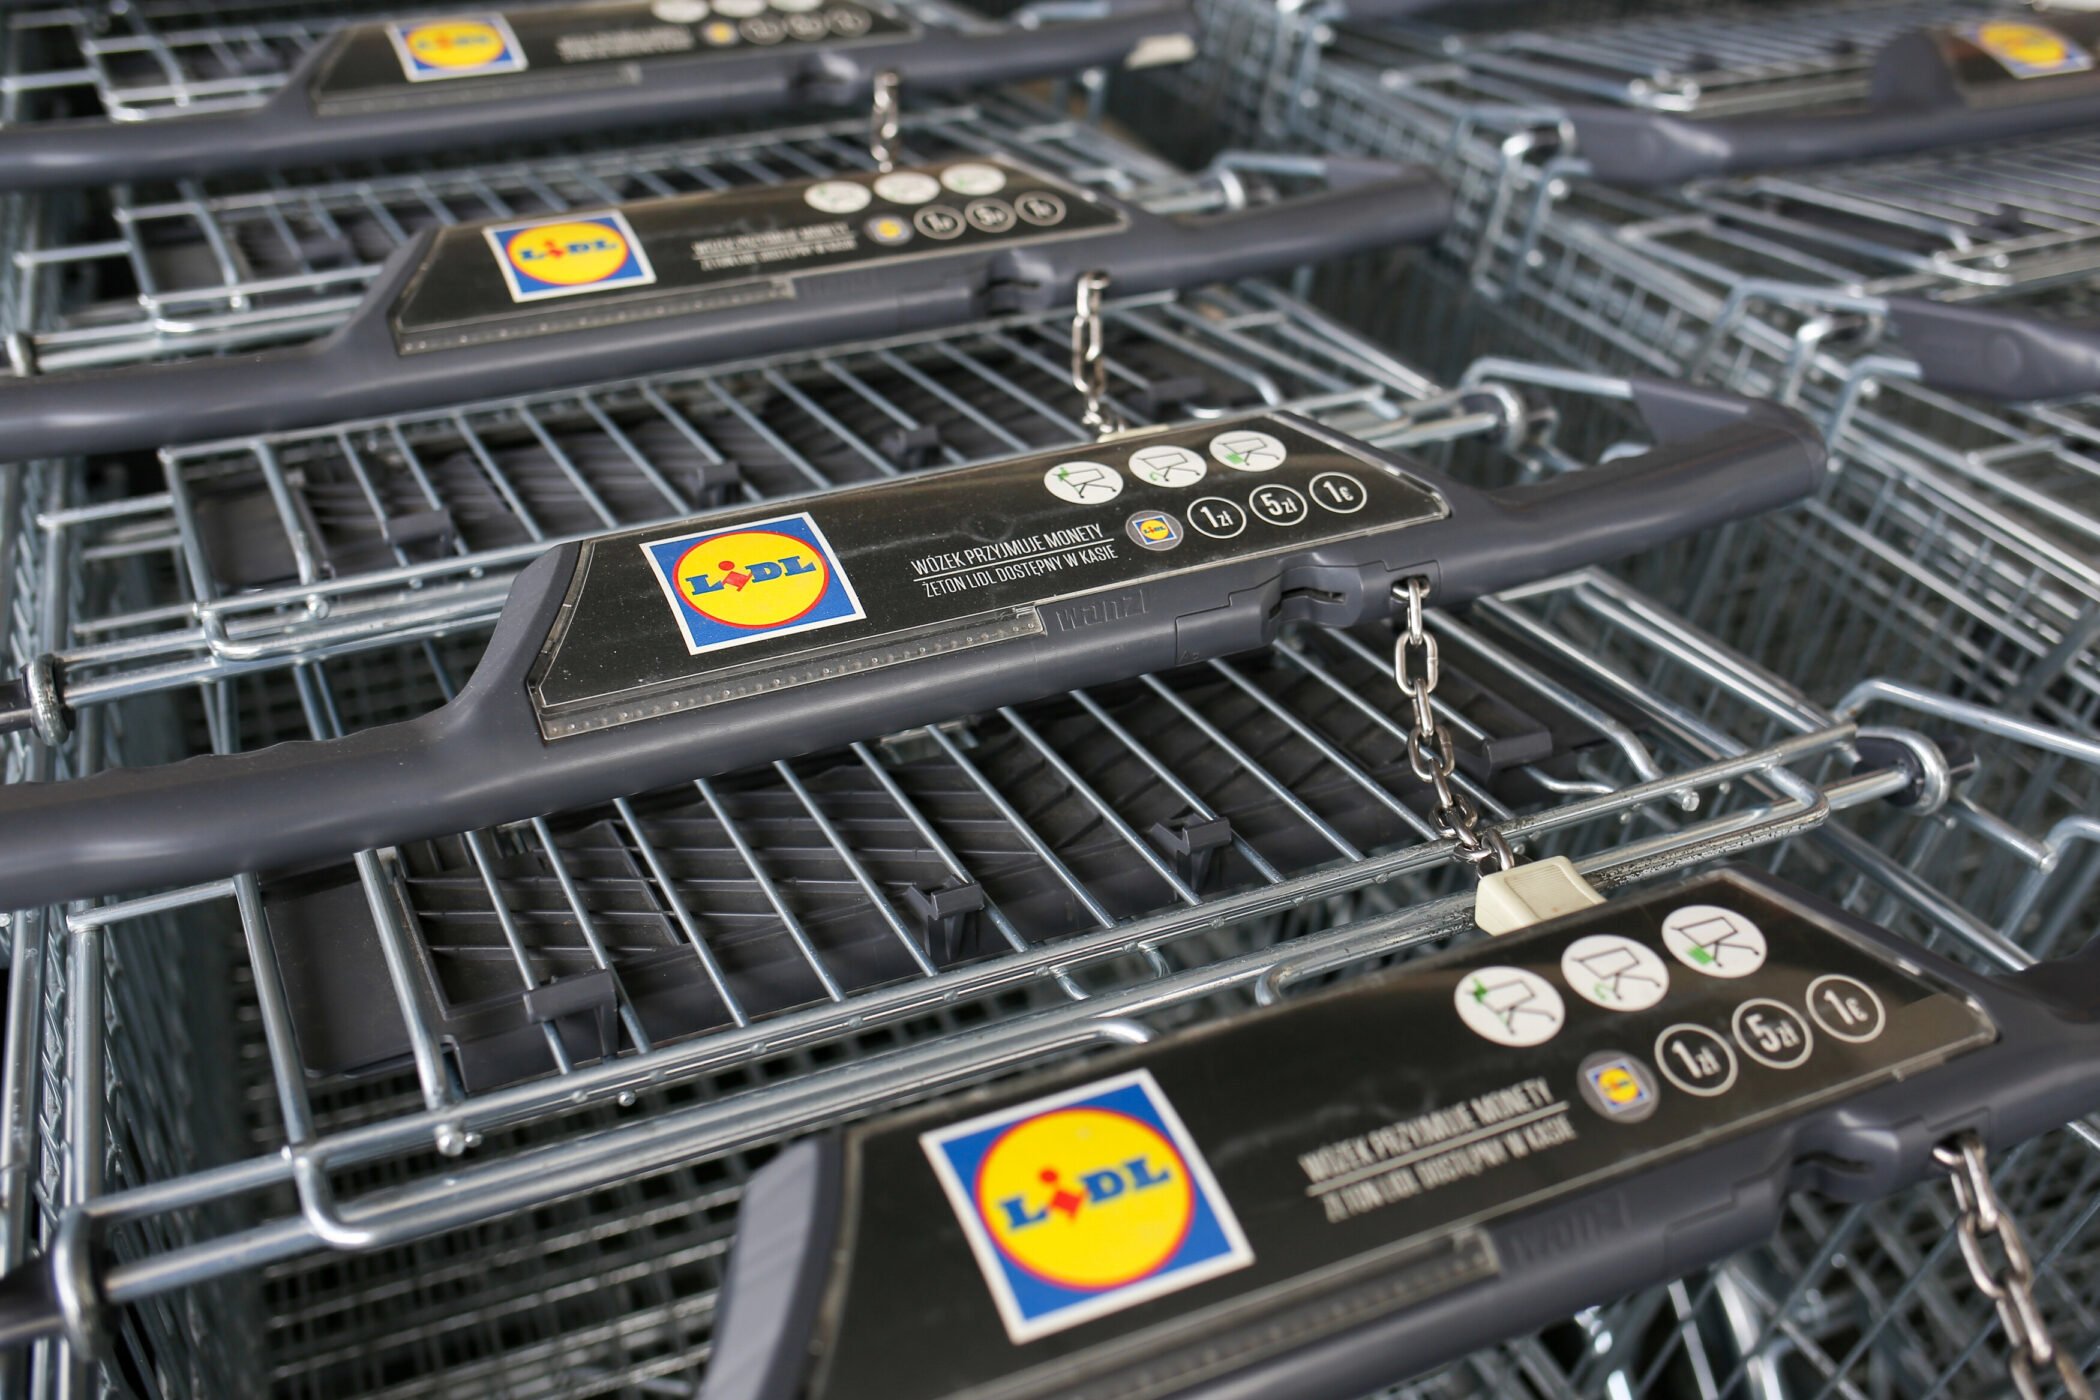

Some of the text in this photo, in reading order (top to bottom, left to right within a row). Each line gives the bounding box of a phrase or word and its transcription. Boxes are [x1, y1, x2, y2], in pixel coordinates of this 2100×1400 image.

[1200, 481, 1354, 528] 1zł 5zł 1€
[911, 523, 1104, 576] WÓZEK PRZYJMUJE MONETY
[922, 544, 1119, 598] ŻETON LIDL DOSTĘPNY W KASIE
